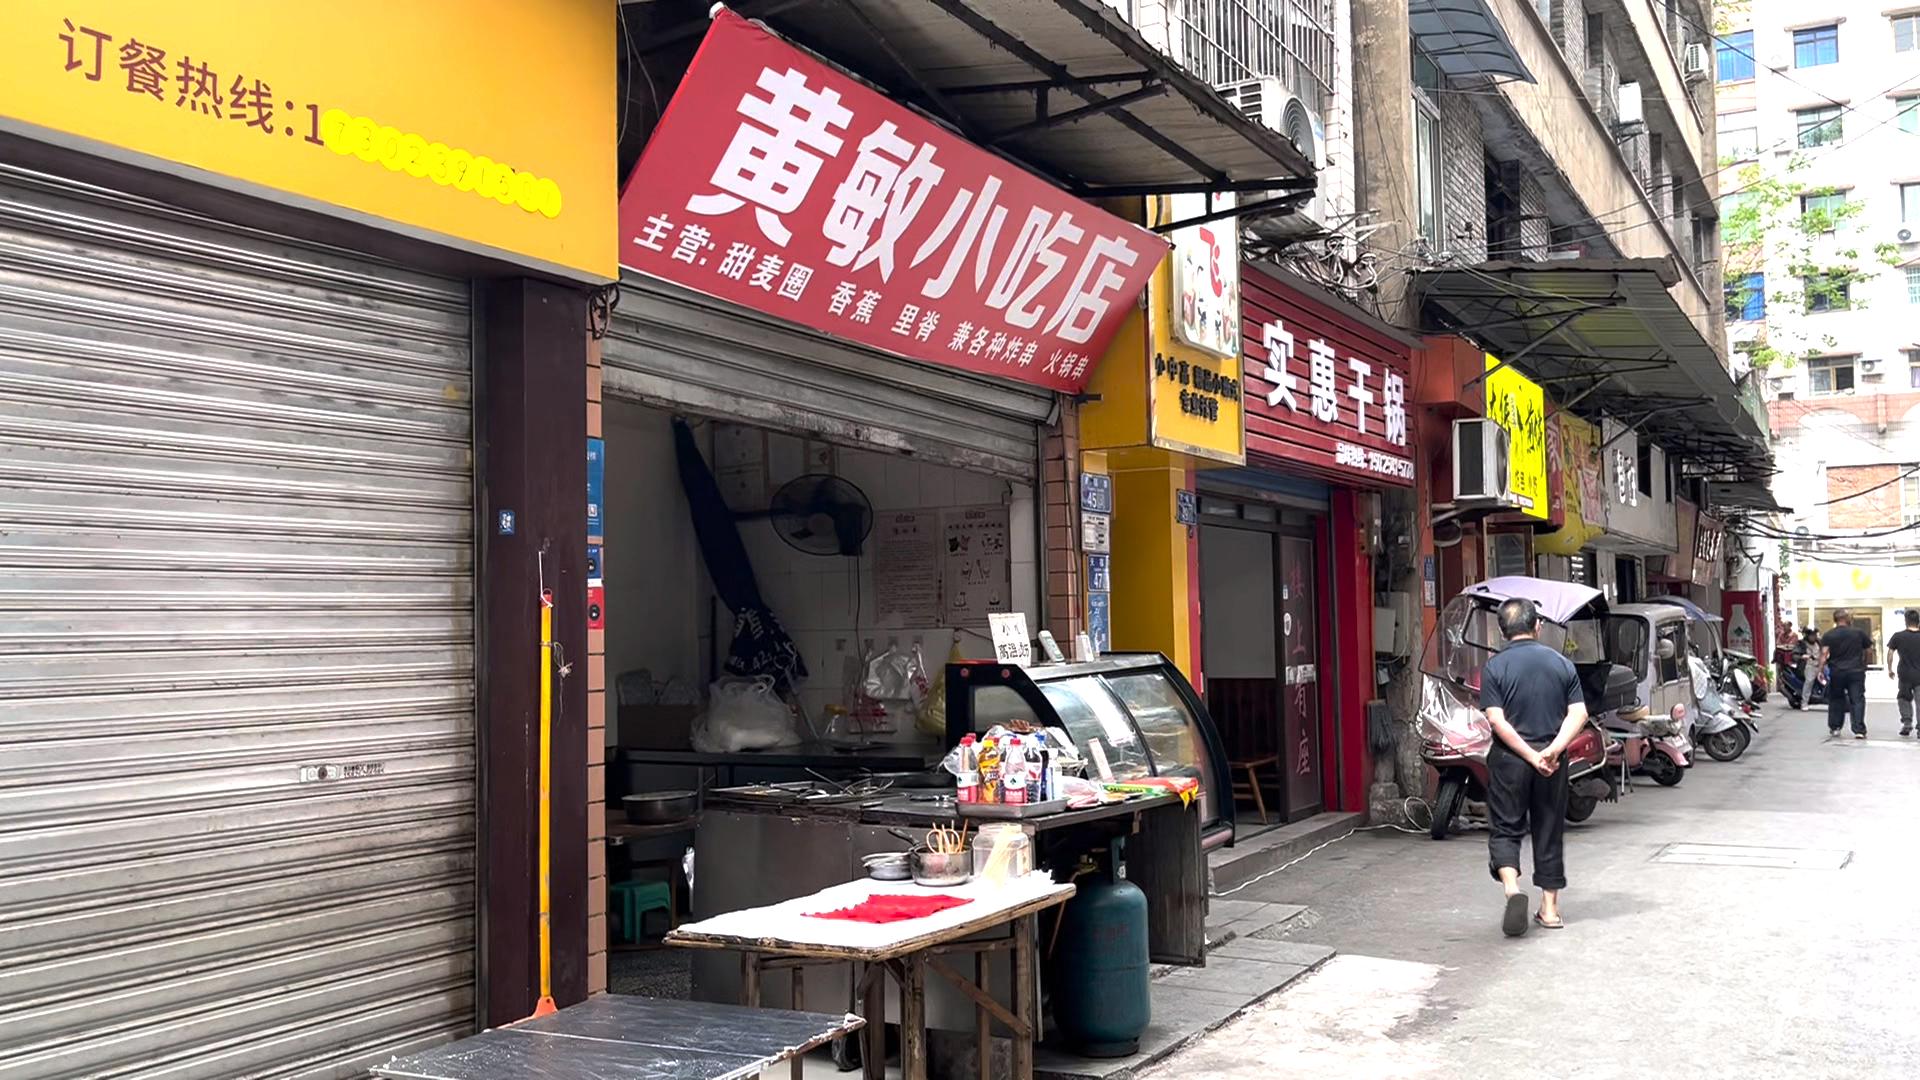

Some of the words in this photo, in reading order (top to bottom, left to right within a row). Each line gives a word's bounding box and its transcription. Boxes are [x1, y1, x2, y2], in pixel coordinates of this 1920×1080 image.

[685, 65, 1139, 345] 黄敏小吃店
[828, 280, 883, 325] 香蕉
[890, 303, 939, 342] 里脊
[947, 320, 1039, 367] 兼各种炸串
[1042, 350, 1090, 380] 火锅串
[1262, 319, 1407, 447] 实惠干锅
[1093, 572, 1103, 589] 47
